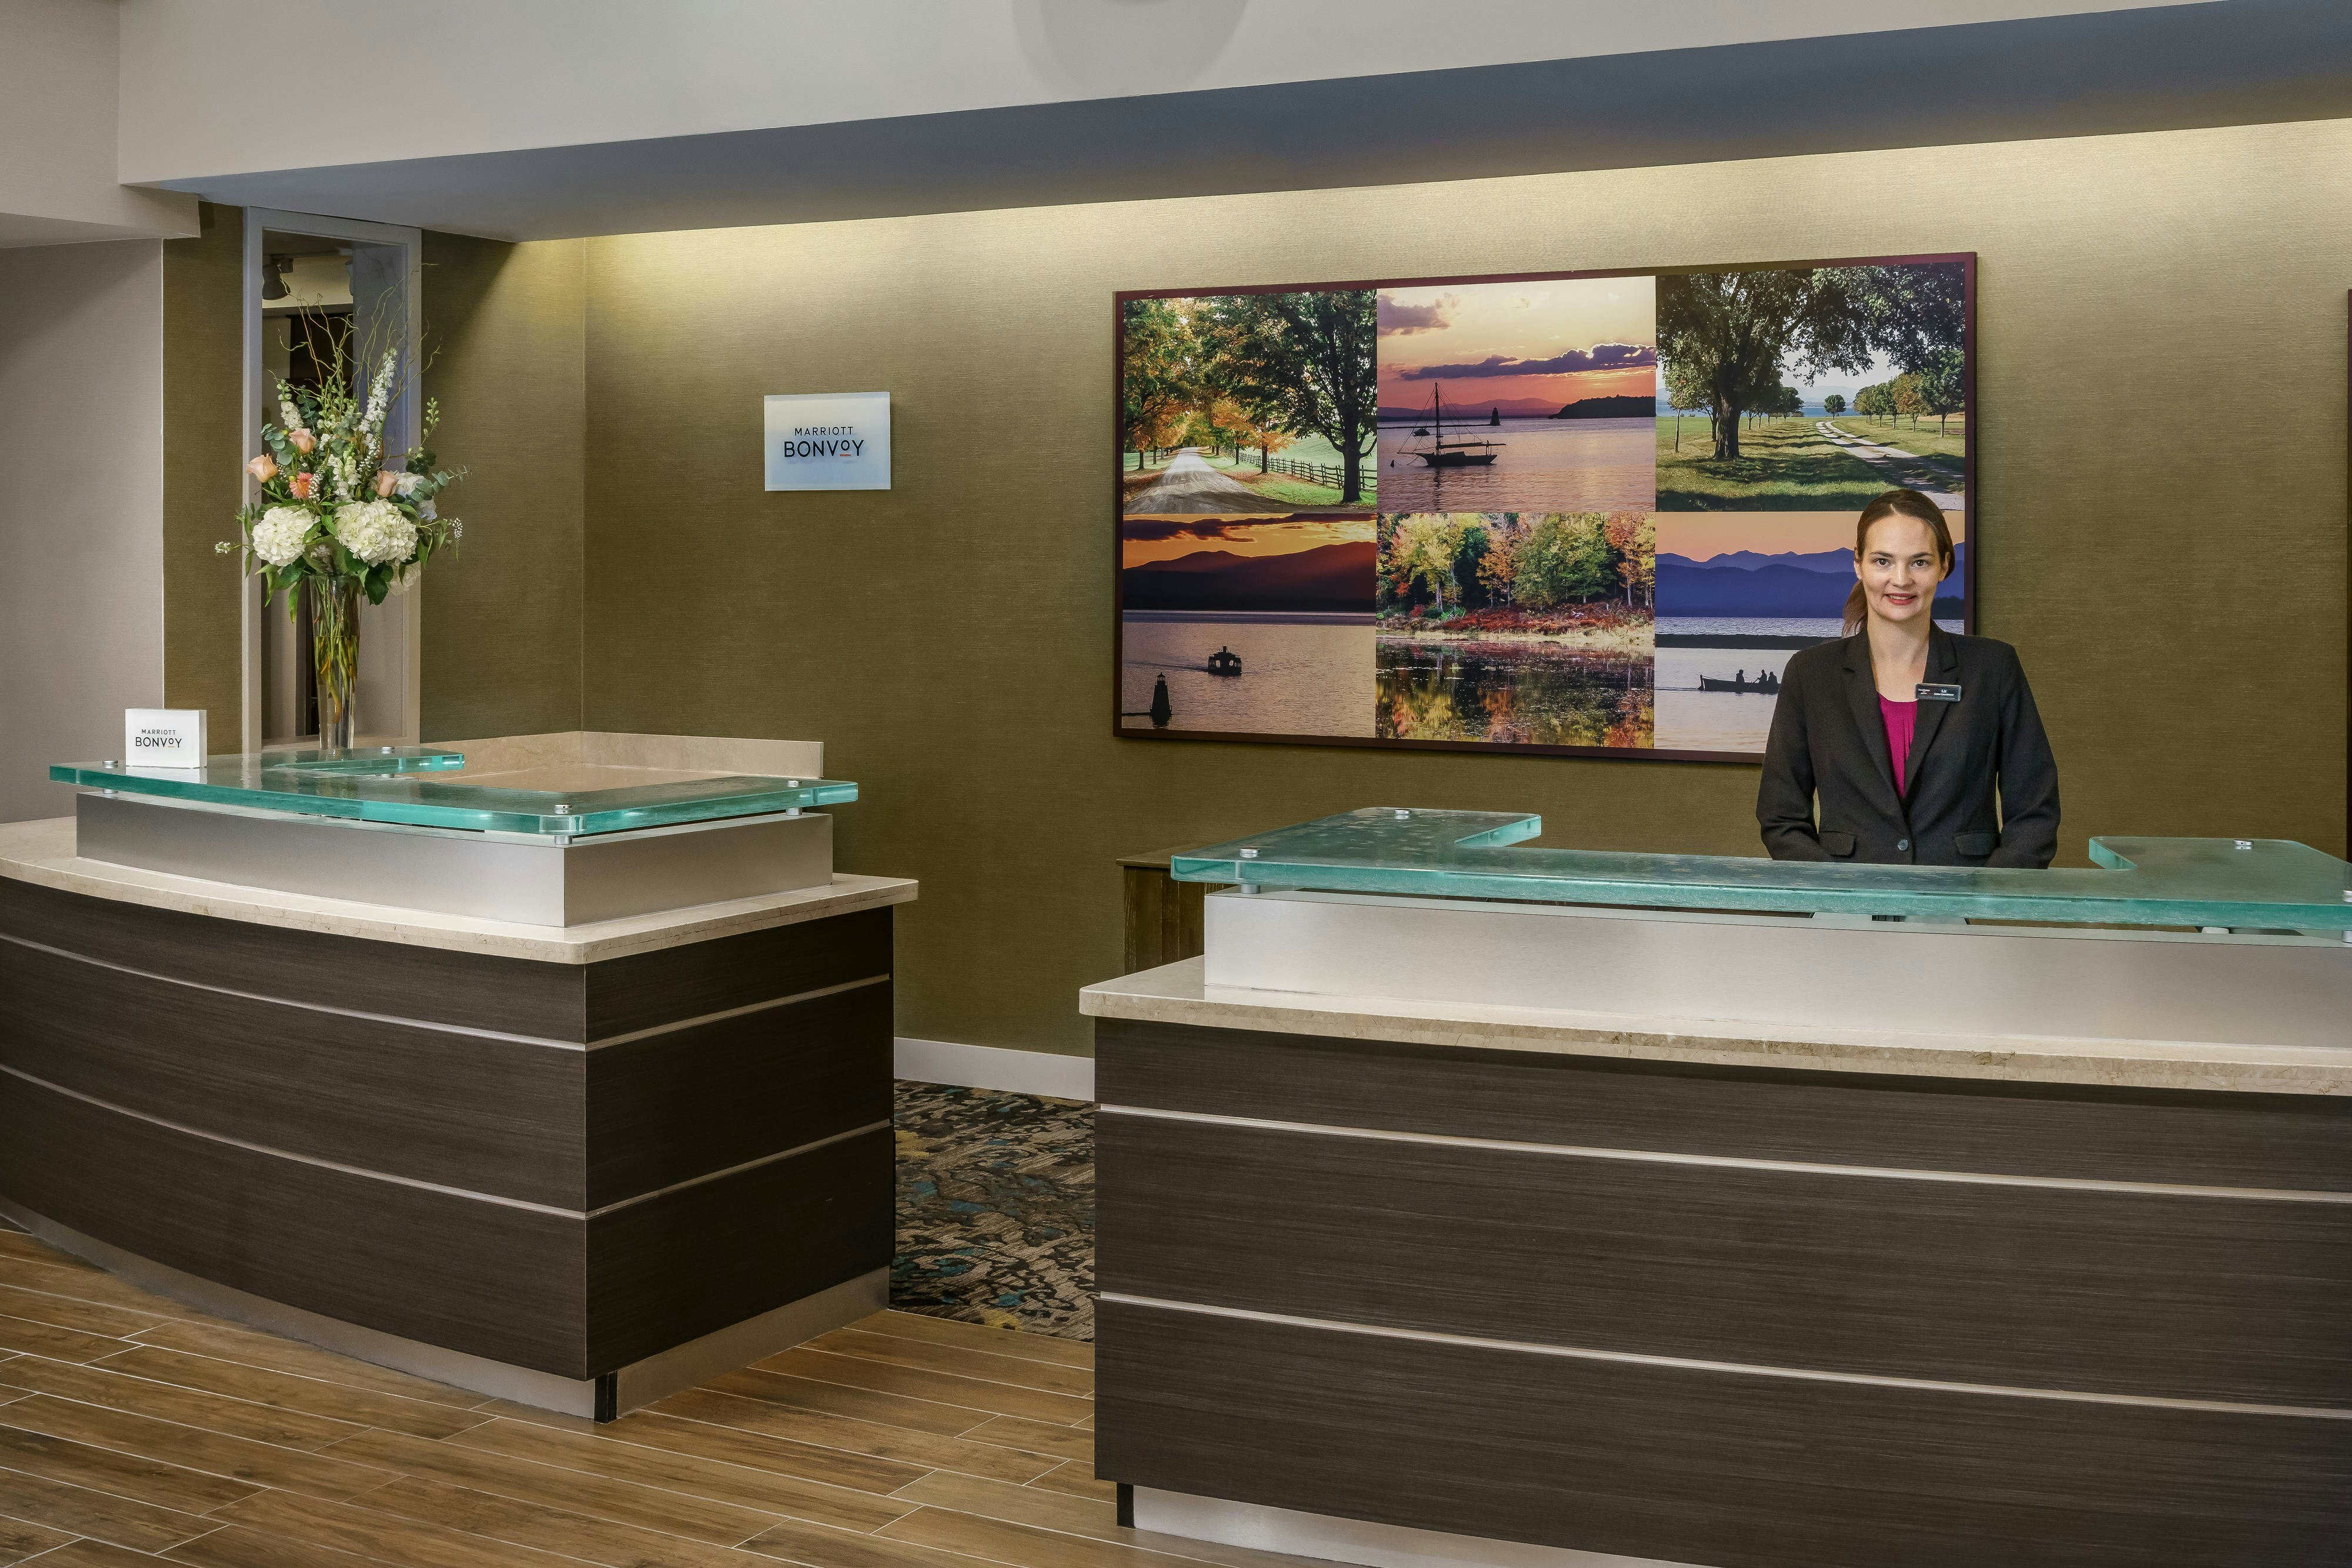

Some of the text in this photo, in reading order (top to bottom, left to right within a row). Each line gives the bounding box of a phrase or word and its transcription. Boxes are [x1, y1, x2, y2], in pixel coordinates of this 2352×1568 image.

[794, 426, 853, 436] MARRIOTT
[784, 439, 864, 457] BONVOY
[135, 737, 182, 748] BONVOY
